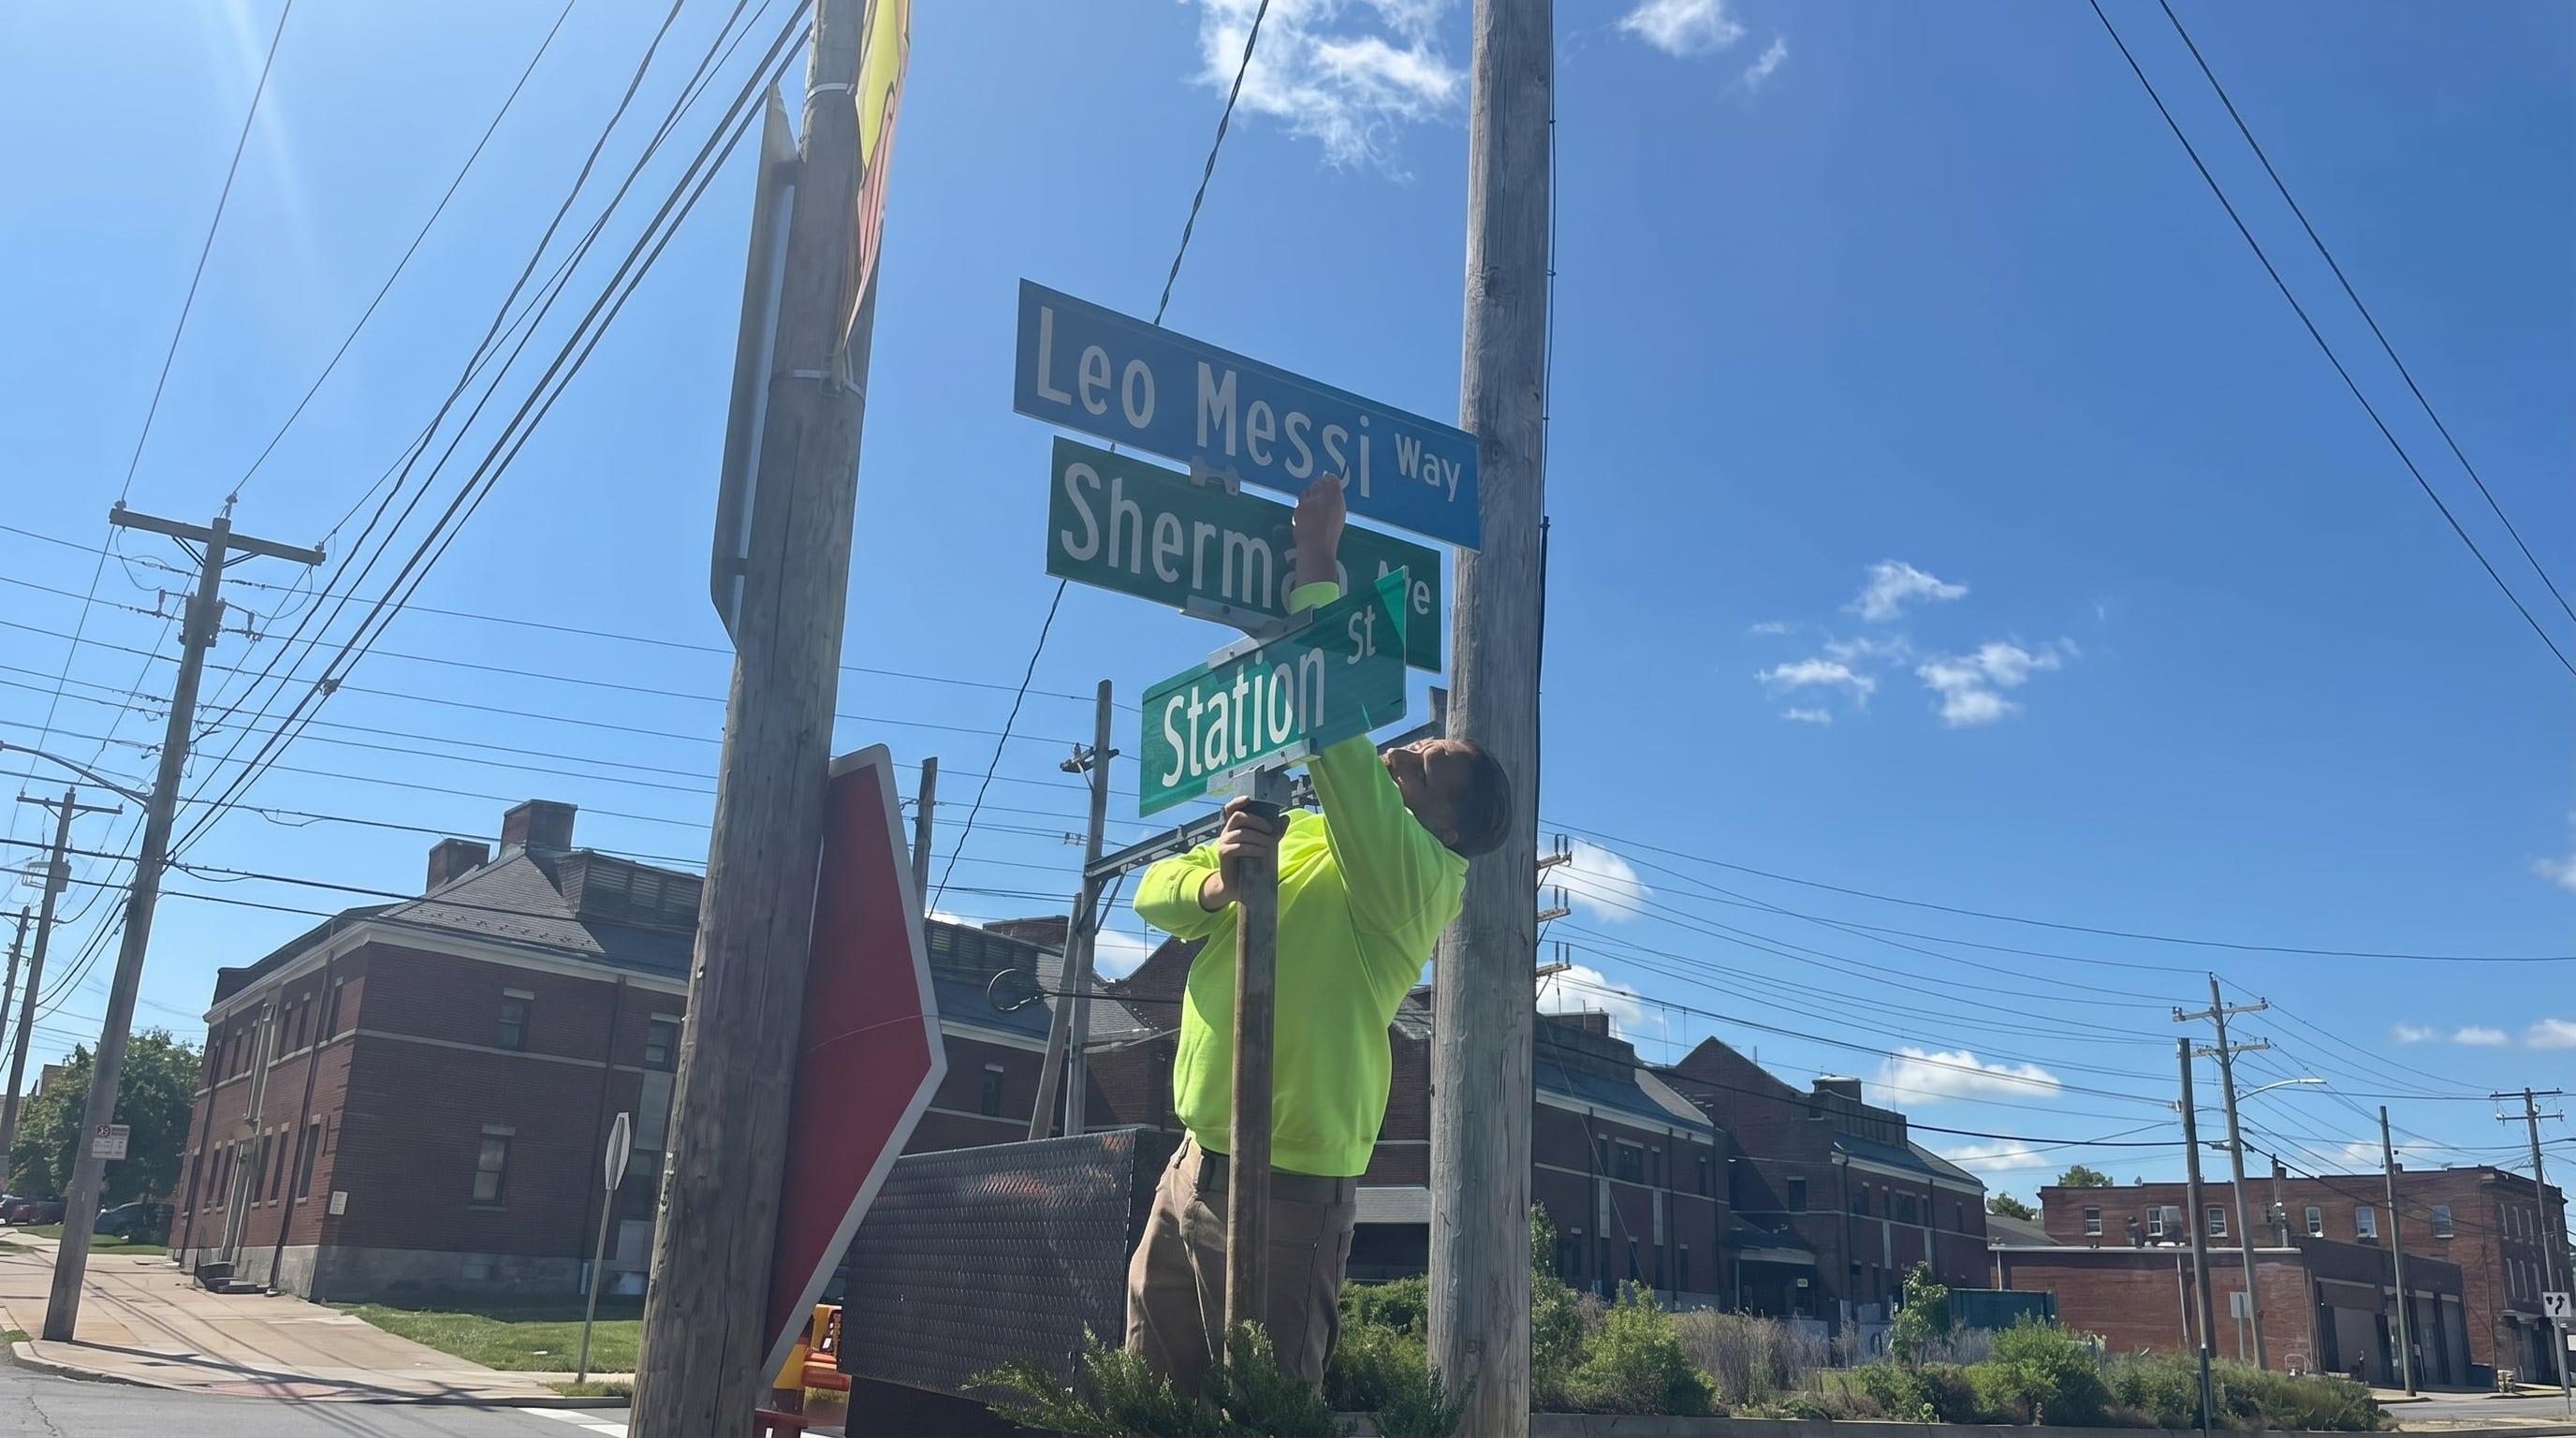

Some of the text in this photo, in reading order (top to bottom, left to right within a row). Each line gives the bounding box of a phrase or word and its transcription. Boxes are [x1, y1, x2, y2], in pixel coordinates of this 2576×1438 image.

[1037, 305, 1461, 502] Leo Messi Way
[1161, 605, 1376, 787] Station St
